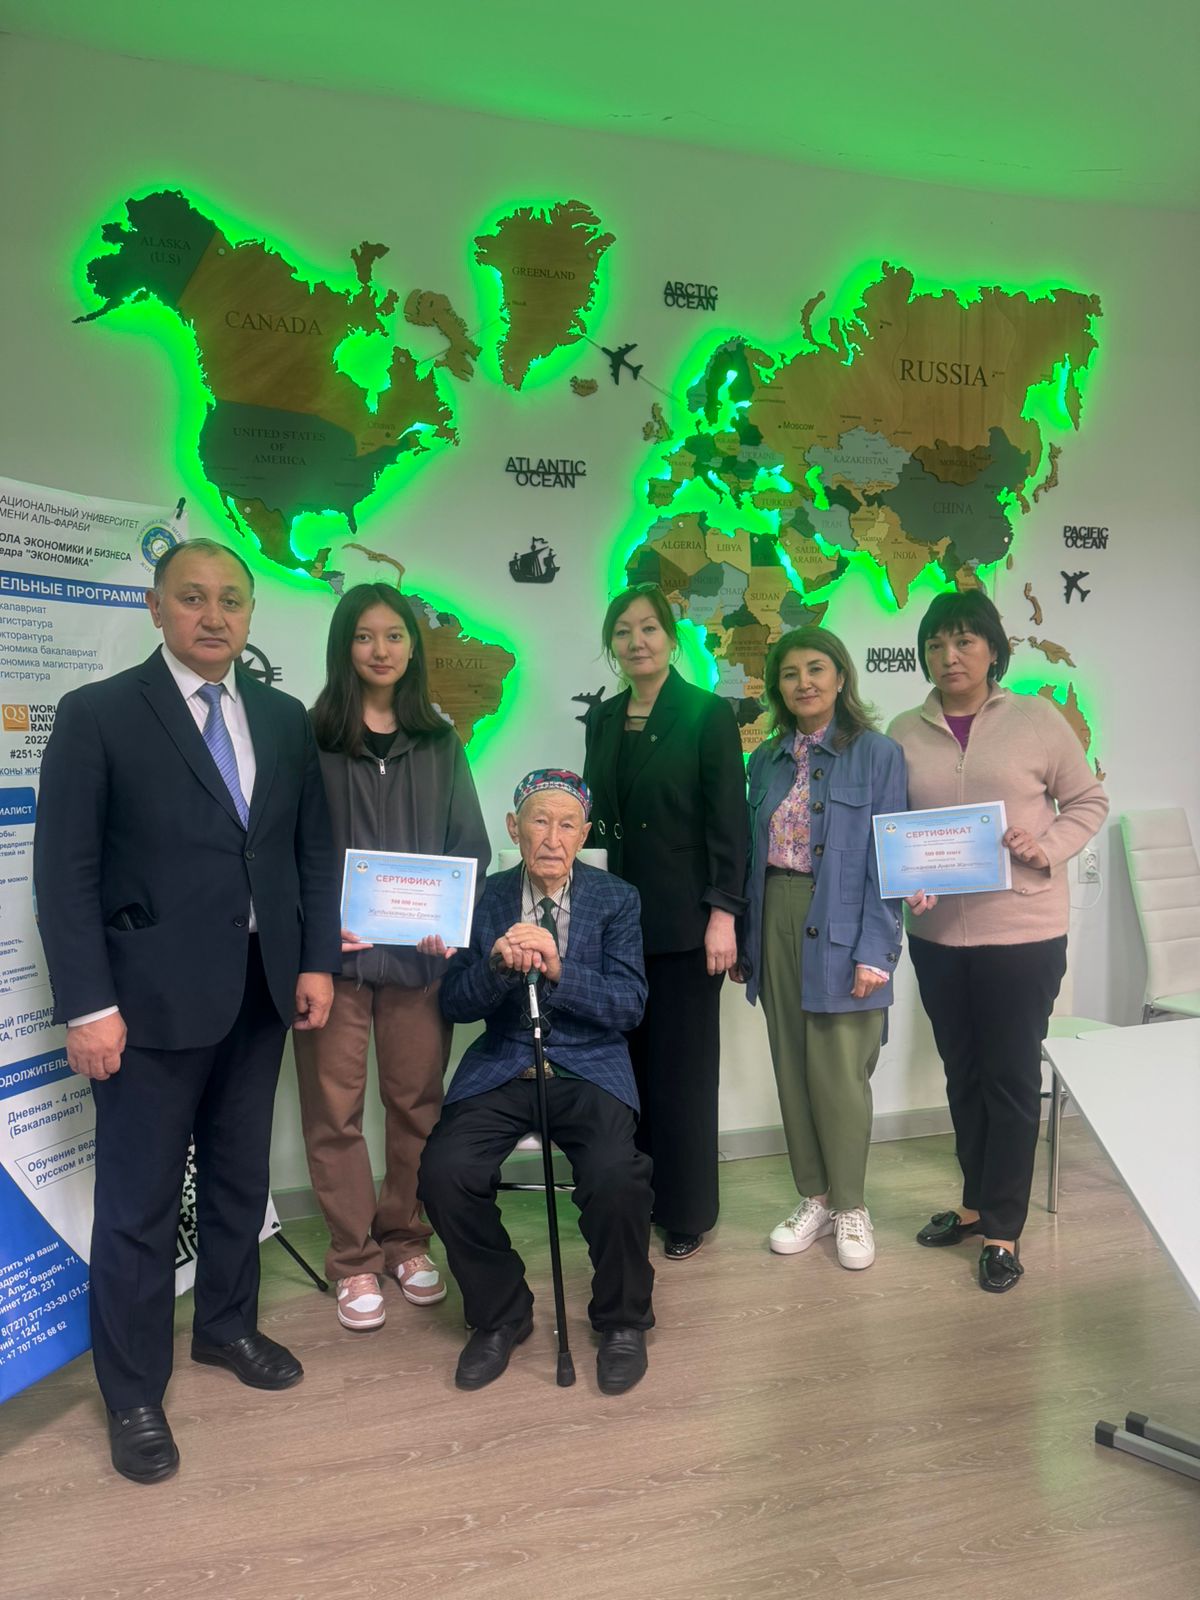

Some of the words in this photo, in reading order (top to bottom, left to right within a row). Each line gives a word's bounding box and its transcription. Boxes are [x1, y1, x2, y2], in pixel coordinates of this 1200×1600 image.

[141, 236, 191, 250] ALASKA
[512, 267, 575, 281] GREENLAND
[664, 281, 718, 299] ARCTIC
[664, 294, 716, 311] OCEAN
[225, 311, 322, 336] CANADA
[900, 359, 988, 387] RUSSIA
[783, 421, 815, 430] Moscow
[233, 427, 280, 439] UNITED
[282, 430, 327, 442] STATES
[270, 442, 287, 452] OF
[254, 454, 307, 466] AMERICA
[505, 456, 586, 476] ATLANTIC
[833, 455, 888, 465] KAZAKHSTAN
[516, 471, 576, 488] OCEAN
[761, 498, 793, 507] TURKEY
[933, 502, 974, 515] CHINA
[0, 495, 79, 519] АЦИОНАЛЬНЫЙ
[81, 509, 139, 529] УНИВЕРСИТЕТ
[0, 507, 29, 521] МЕНИ
[30, 513, 90, 532] АЛЬ-ФАРАБИ
[822, 519, 843, 528] IRAN
[1063, 526, 1109, 540] PACIFIC
[24, 536, 84, 555] ЭКОНОМИКИ
[86, 546, 93, 556] И
[94, 547, 132, 561] БИЗНЕСА
[661, 541, 702, 550] ALGERIA
[717, 544, 742, 552] LIBYA
[1065, 536, 1107, 549] OCEAN
[795, 546, 819, 554] SAUDI
[893, 551, 917, 560] INDIA
[26, 548, 94, 567] "ЭКОНОМИКА"
[792, 556, 823, 564] ARABIA
[1, 576, 63, 596] ЕЛЬНЫЕ
[664, 579, 687, 588] MALI
[721, 588, 743, 597] CHAD
[750, 593, 780, 601] SUDAN
[41, 645, 97, 657] бакалавриат
[868, 647, 915, 661] INDIAN
[0, 657, 40, 668] ономика
[43, 660, 104, 672] магистратура
[435, 658, 487, 670] BRAZIL
[866, 659, 916, 672] OCEAN
[4, 705, 28, 724] QS
[30, 714, 55, 722] UNIV
[31, 723, 52, 732] RAN
[25, 735, 48, 745] 2022
[905, 826, 972, 838] СЕРТИФИКАТ
[375, 874, 443, 887] СЕРТИФИКАТ
[8, 1100, 53, 1124] Дневная
[62, 1093, 68, 1103] 4
[10, 1102, 83, 1139] (Бакалавриат)
[27, 1146, 76, 1172] Обучение
[35, 1160, 77, 1185] русском
[24, 1253, 35, 1263] на
[37, 1241, 60, 1256] ваши
[30, 1262, 66, 1285] Фараби,
[65, 1256, 79, 1266] 71,
[22, 1288, 41, 1302] 223,
[41, 1279, 56, 1292] 231
[1, 1315, 28, 1337] 8(727)
[29, 1294, 68, 1322] 377-33-30
[21, 1321, 41, 1338] 1247
[6, 1349, 16, 1360] +7
[17, 1342, 31, 1355] 707
[32, 1332, 47, 1345] 752
[57, 1320, 68, 1332] 62
